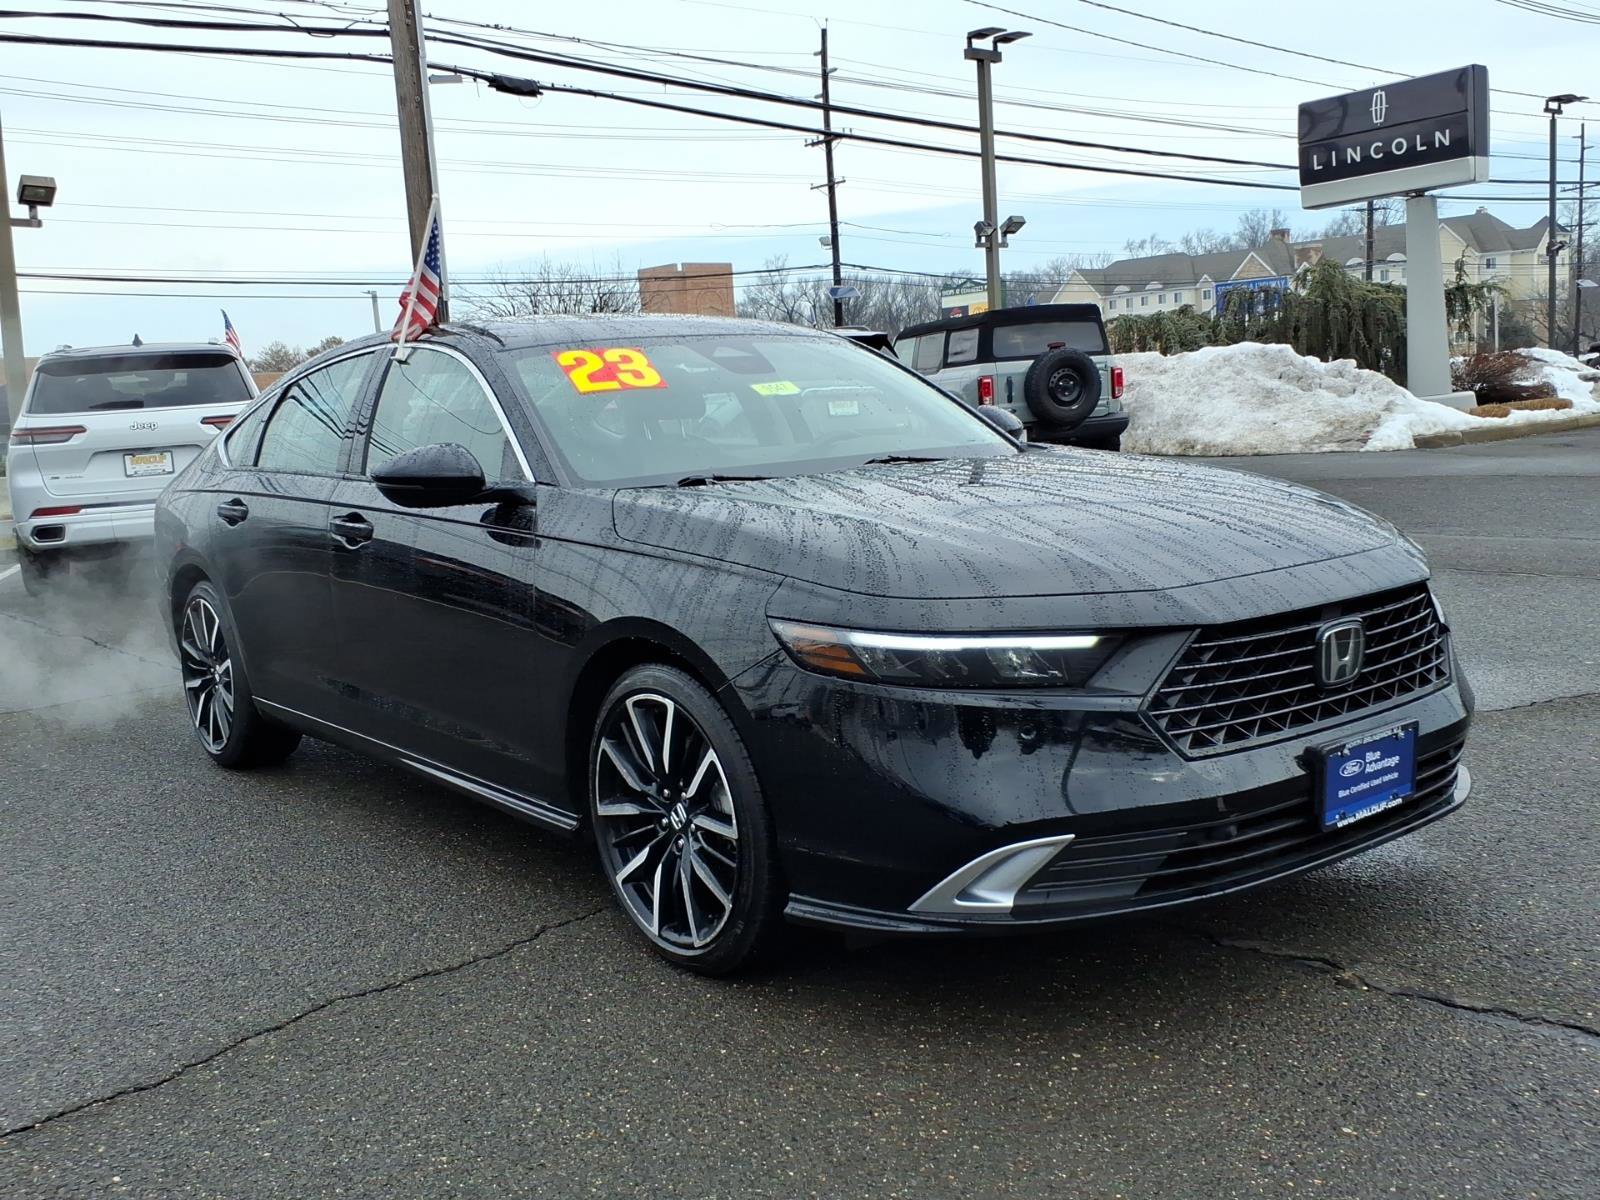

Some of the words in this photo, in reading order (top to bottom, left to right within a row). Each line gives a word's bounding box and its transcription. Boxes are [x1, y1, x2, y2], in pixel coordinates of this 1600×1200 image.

[1313, 129, 1450, 170] LINCOLN
[557, 348, 661, 392] 23
[130, 421, 159, 431] Jeep
[1365, 751, 1381, 762] Blue
[1365, 755, 1400, 773] Advantage
[1338, 789, 1350, 798] Blue
